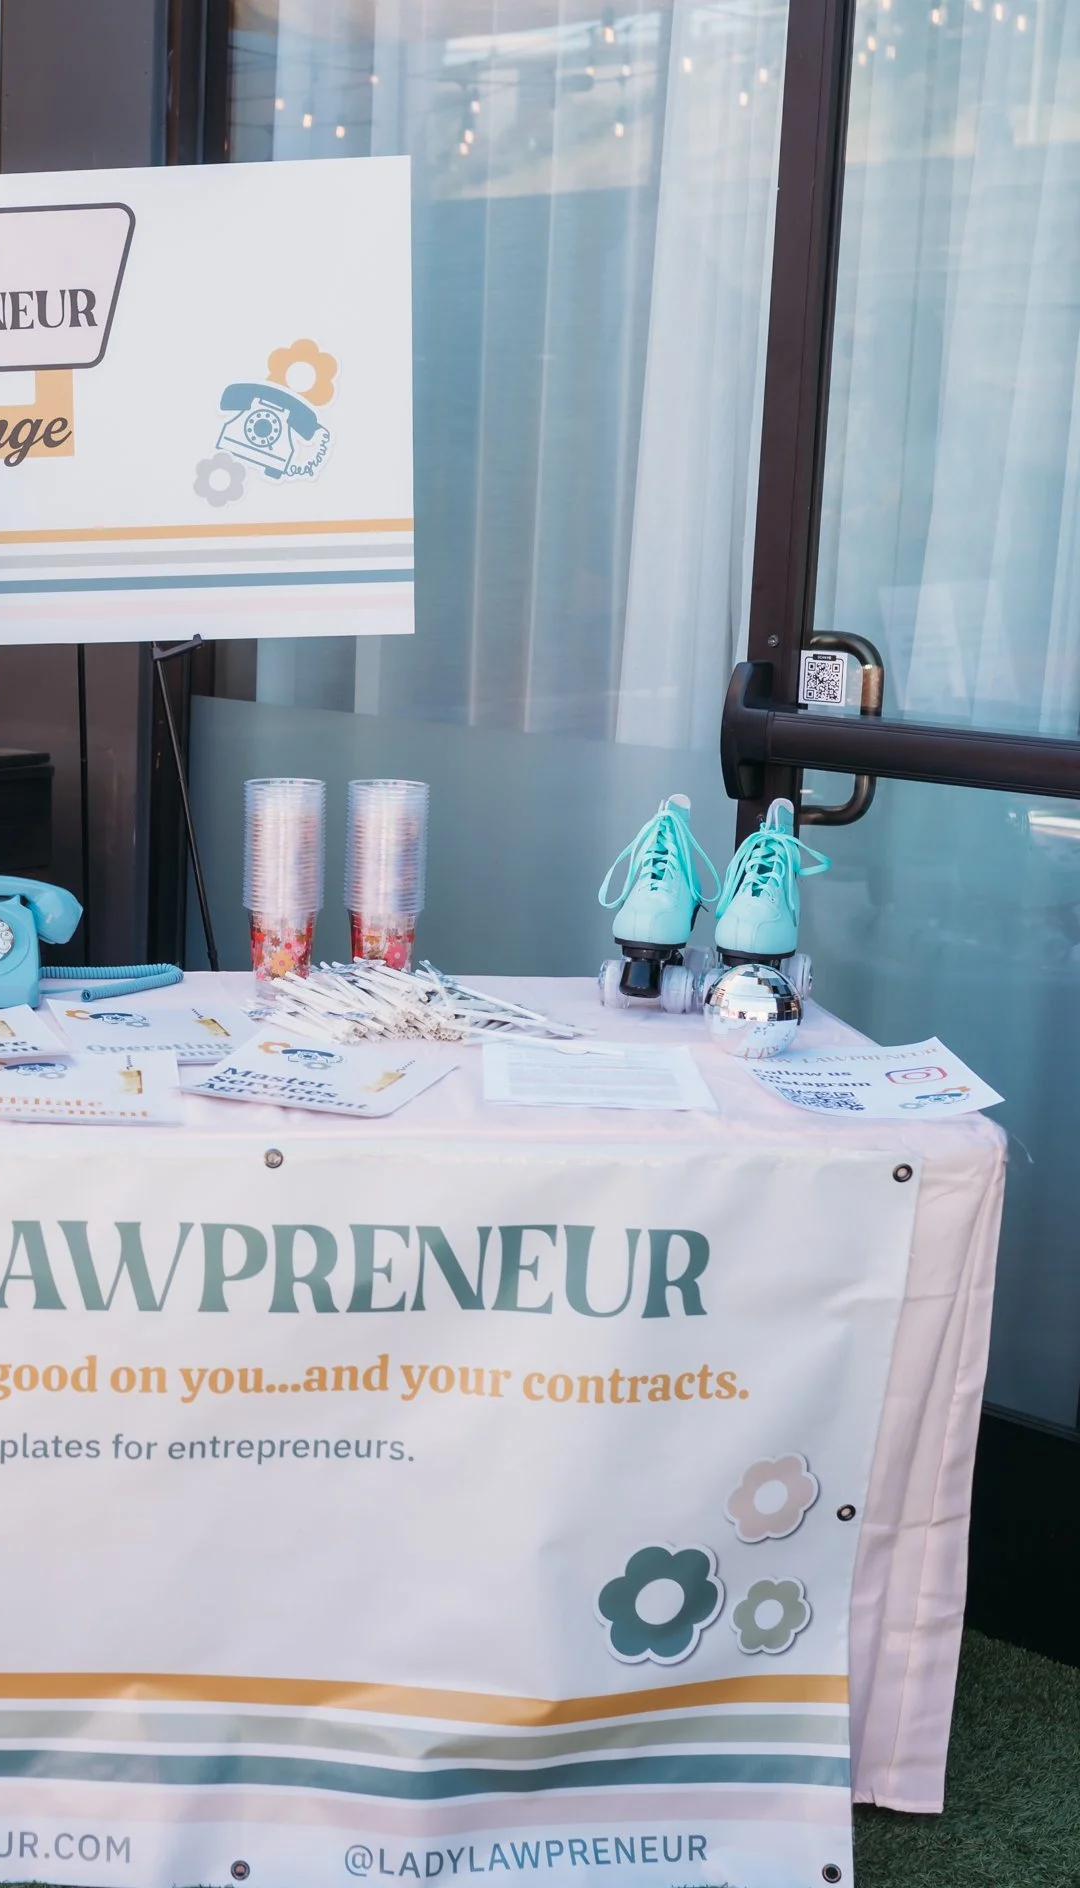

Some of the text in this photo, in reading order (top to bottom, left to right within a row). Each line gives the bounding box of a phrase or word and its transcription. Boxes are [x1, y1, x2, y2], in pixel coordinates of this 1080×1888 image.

[208, 1075, 340, 1098] Services
[222, 1067, 333, 1088] Master
[110, 1365, 167, 1394] on
[179, 1354, 390, 1404] you...and
[400, 1362, 513, 1401] your
[522, 1364, 749, 1404] contracts.
[112, 1433, 157, 1460] for
[167, 1435, 415, 1464] entrepreneurs.
[344, 1835, 708, 1879] @LADYLAWPRENEUR
